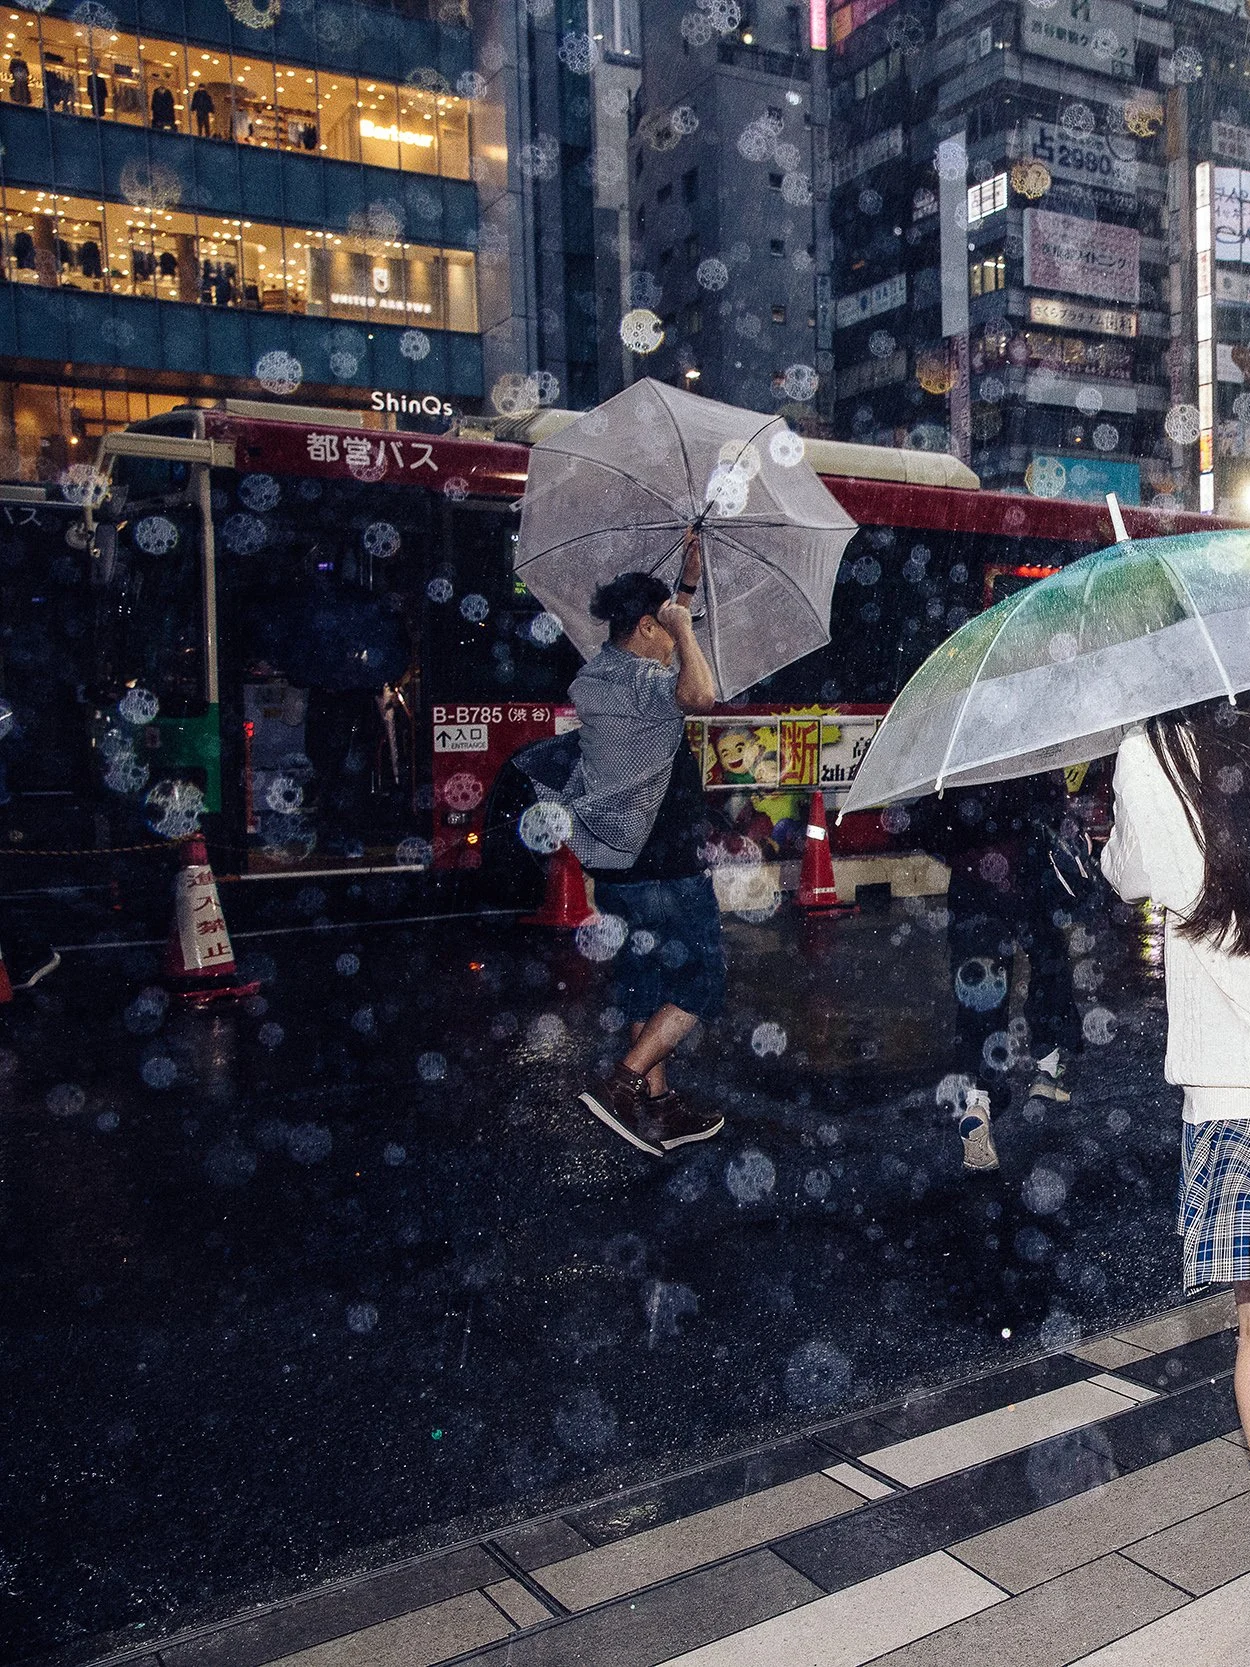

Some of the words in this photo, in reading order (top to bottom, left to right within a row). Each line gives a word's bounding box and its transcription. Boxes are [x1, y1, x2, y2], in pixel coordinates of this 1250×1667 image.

[1058, 143, 1113, 176] 2980
[371, 391, 453, 416] ShinQs
[307, 432, 439, 472] 都営バス
[433, 706, 503, 724] B-B785
[451, 741, 486, 750] ENTRANCE
[454, 728, 482, 742] 入口
[186, 871, 230, 959] 進入禁止
